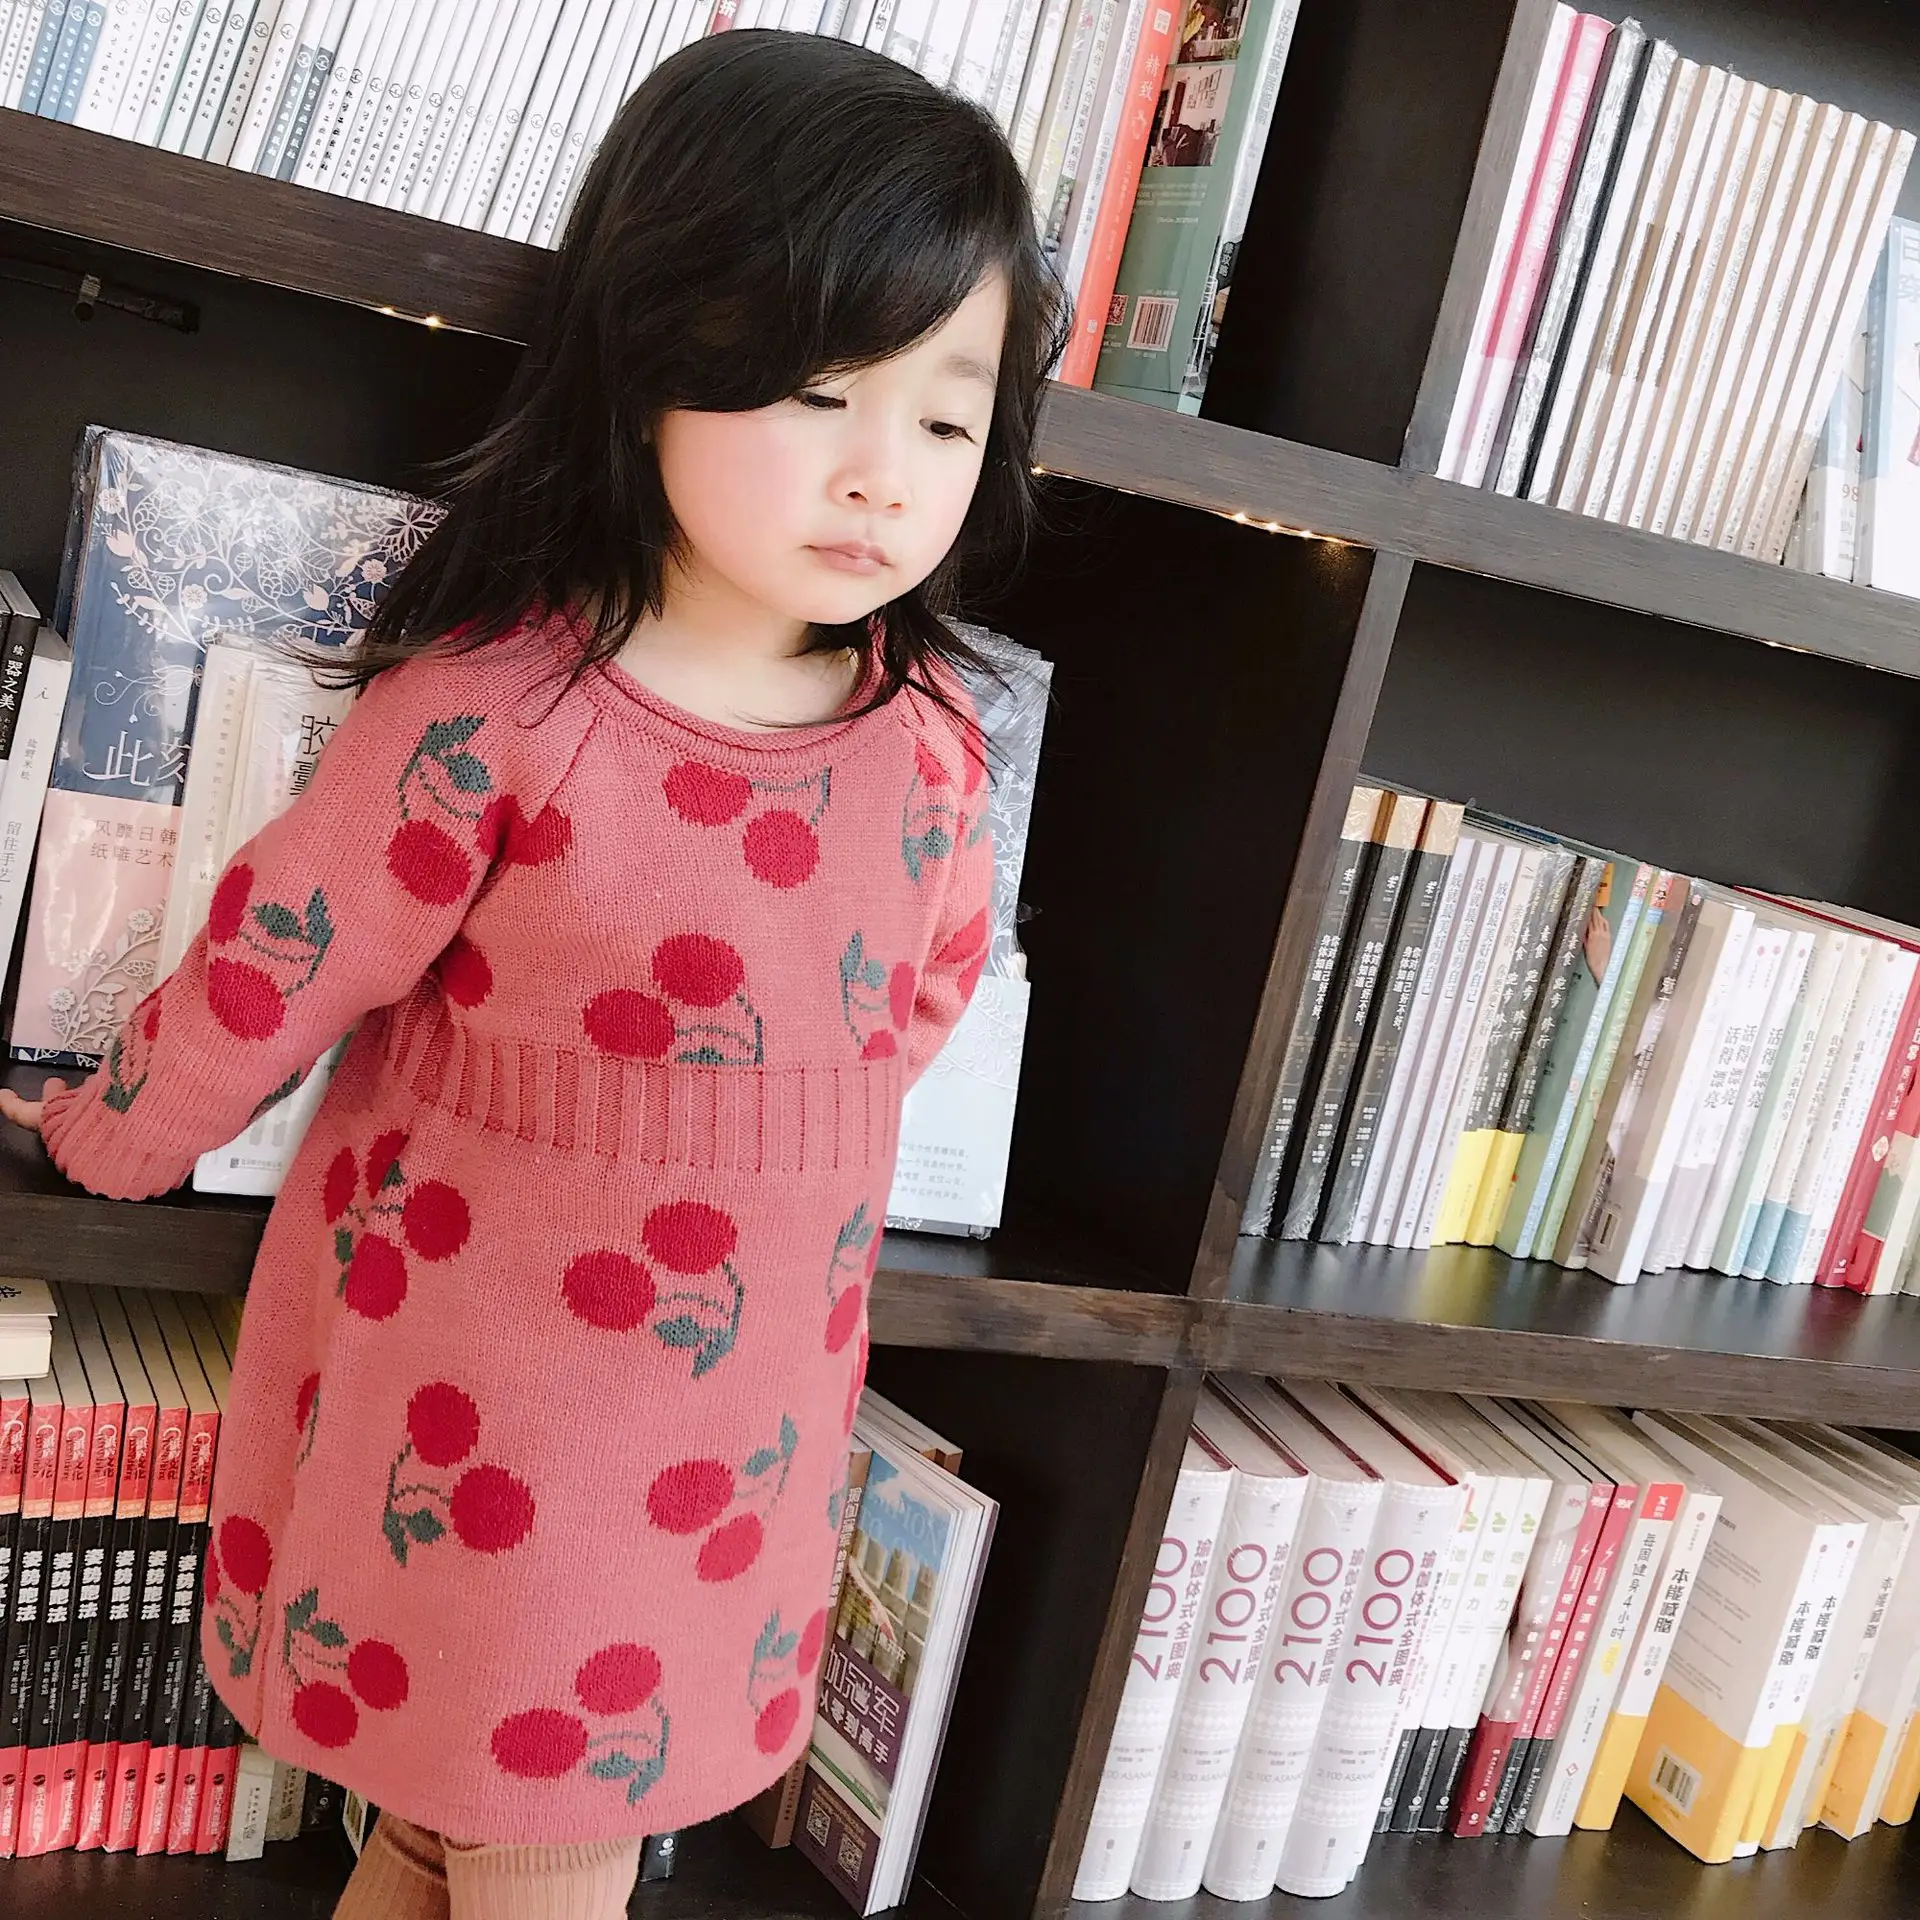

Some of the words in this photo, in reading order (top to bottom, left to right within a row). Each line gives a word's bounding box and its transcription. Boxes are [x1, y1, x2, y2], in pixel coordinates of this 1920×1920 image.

[0, 821, 21, 883] 留住手艺
[89, 843, 174, 868] 纸雕艺术
[94, 819, 177, 846] 风靡日韩
[1200, 1544, 1268, 1685] 2100
[1274, 1548, 1344, 1687] 2100
[1346, 1549, 1414, 1687] 2100
